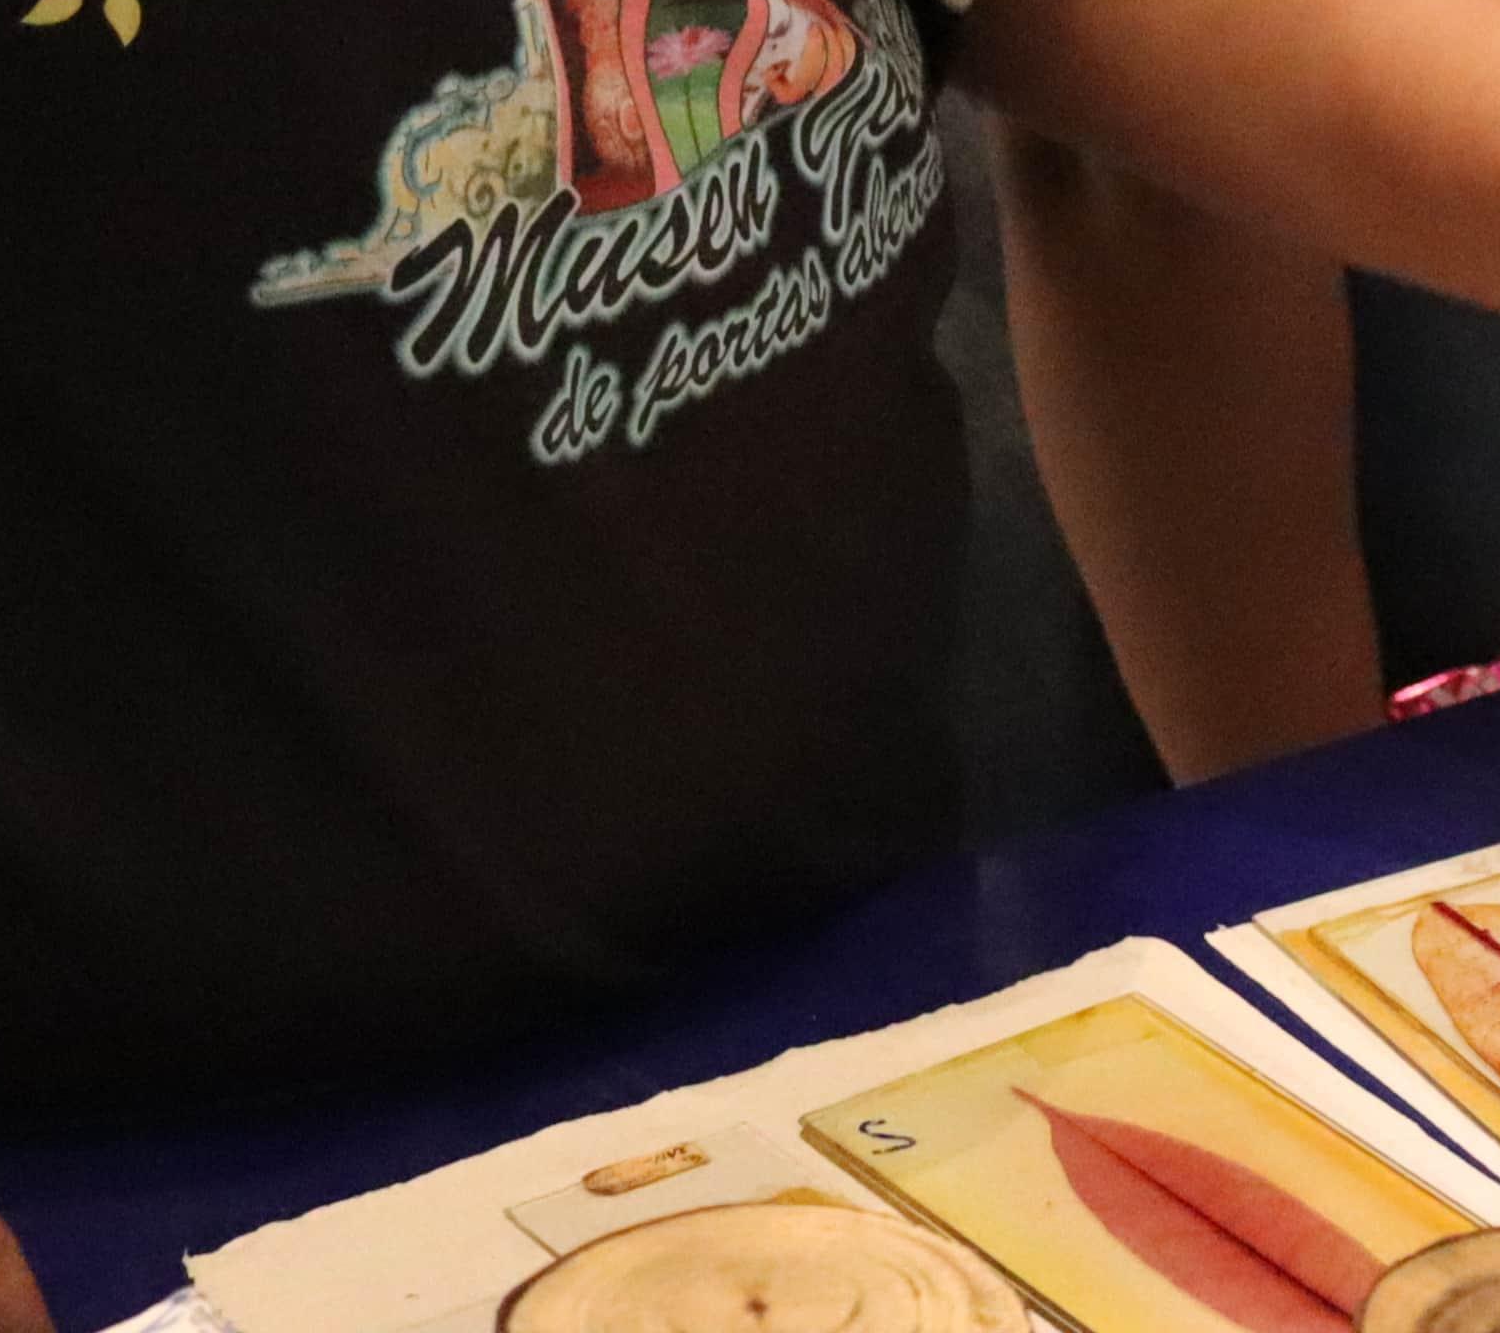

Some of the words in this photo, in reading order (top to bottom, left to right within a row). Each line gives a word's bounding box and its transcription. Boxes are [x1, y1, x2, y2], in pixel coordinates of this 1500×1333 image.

[386, 131, 778, 371] Museu
[536, 345, 617, 459] de
[632, 251, 828, 441] portas
